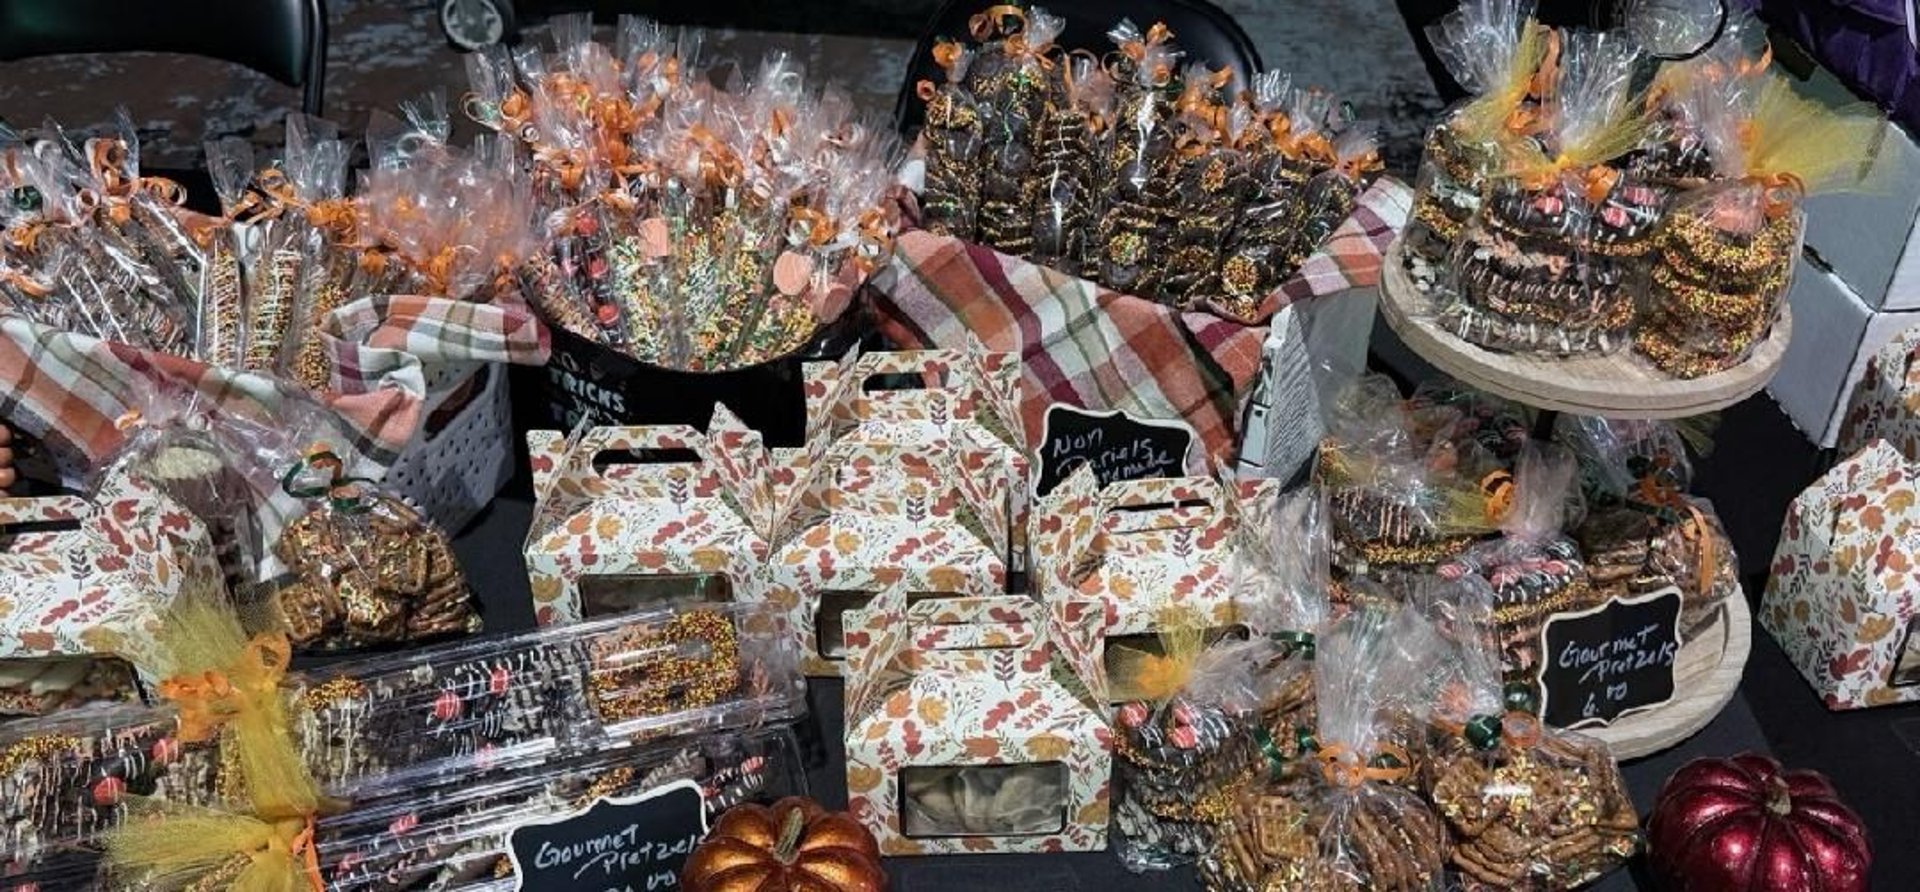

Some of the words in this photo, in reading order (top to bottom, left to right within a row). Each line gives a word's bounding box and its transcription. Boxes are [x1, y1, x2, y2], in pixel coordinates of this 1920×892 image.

[550, 366, 626, 413] TRICKS
[1053, 428, 1102, 457] Non
[1559, 624, 1659, 668] Gourmet
[534, 824, 639, 868] Gourmet
